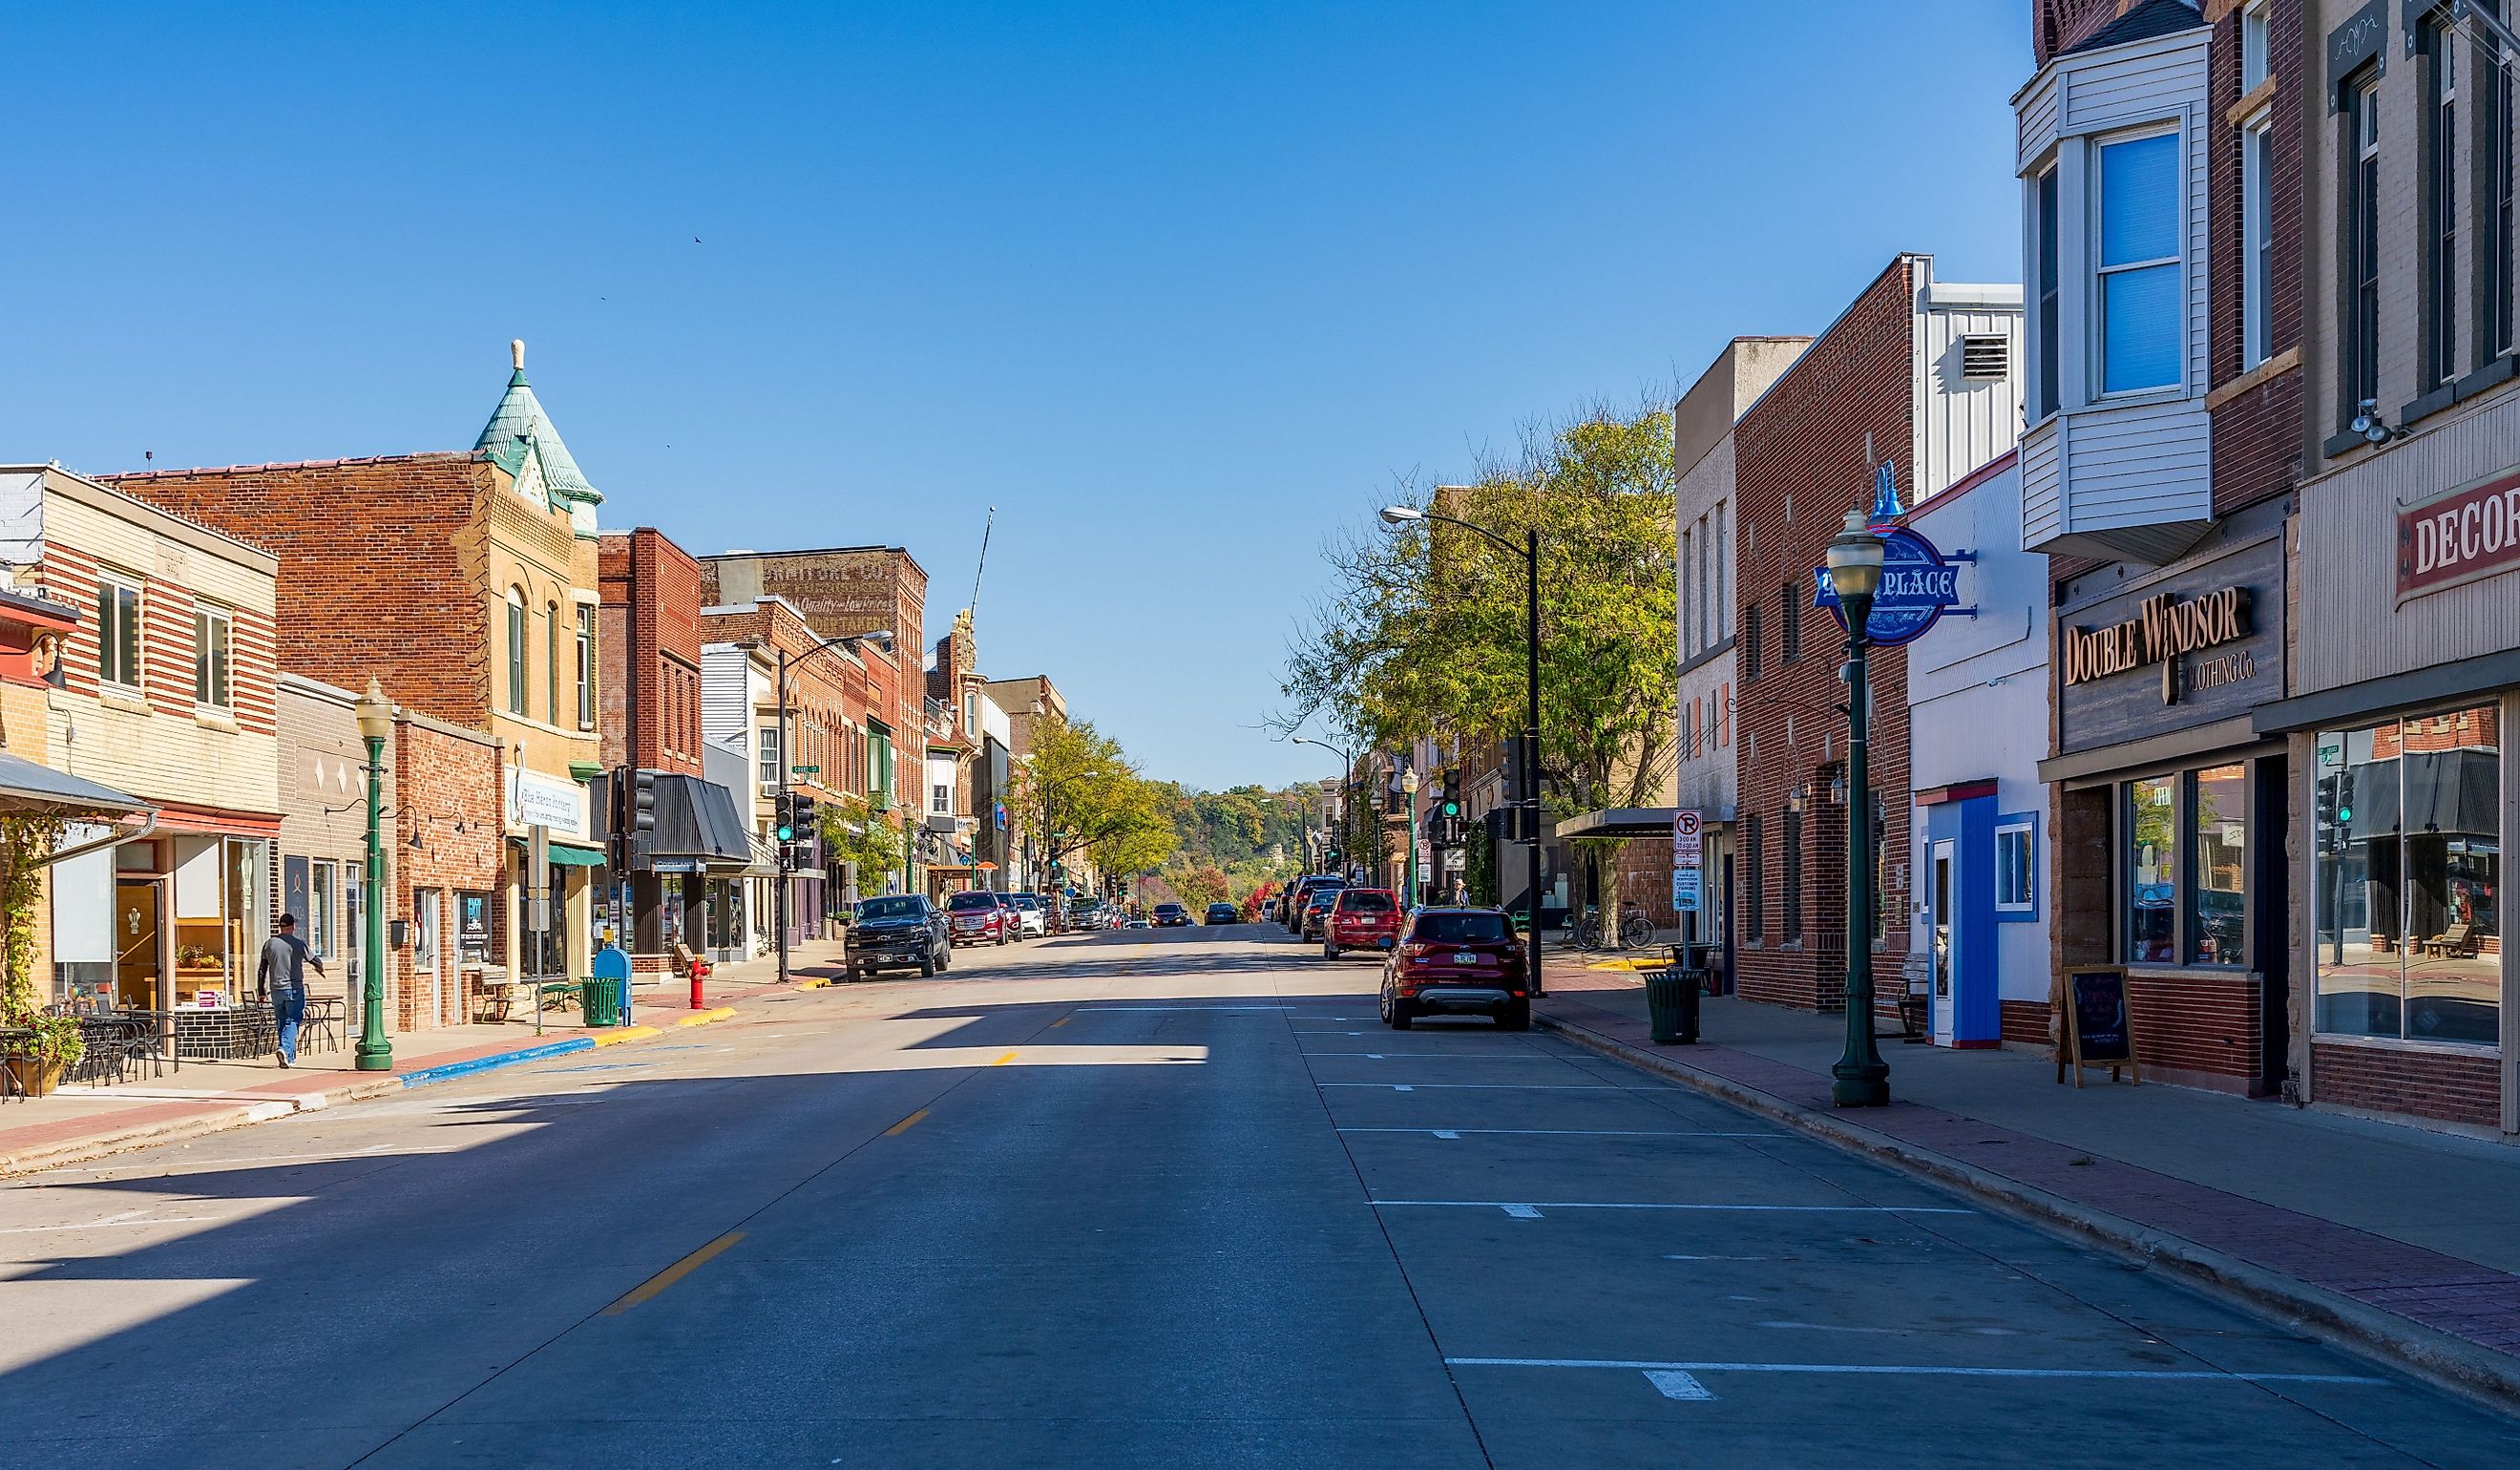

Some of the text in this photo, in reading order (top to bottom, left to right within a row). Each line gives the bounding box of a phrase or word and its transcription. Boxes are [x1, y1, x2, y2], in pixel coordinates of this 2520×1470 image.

[2416, 488, 2520, 575] DECOR
[1883, 571, 1953, 598] PLACE
[2066, 620, 2137, 685] DOUBLE
[2187, 653, 2238, 693] CLOTHING
